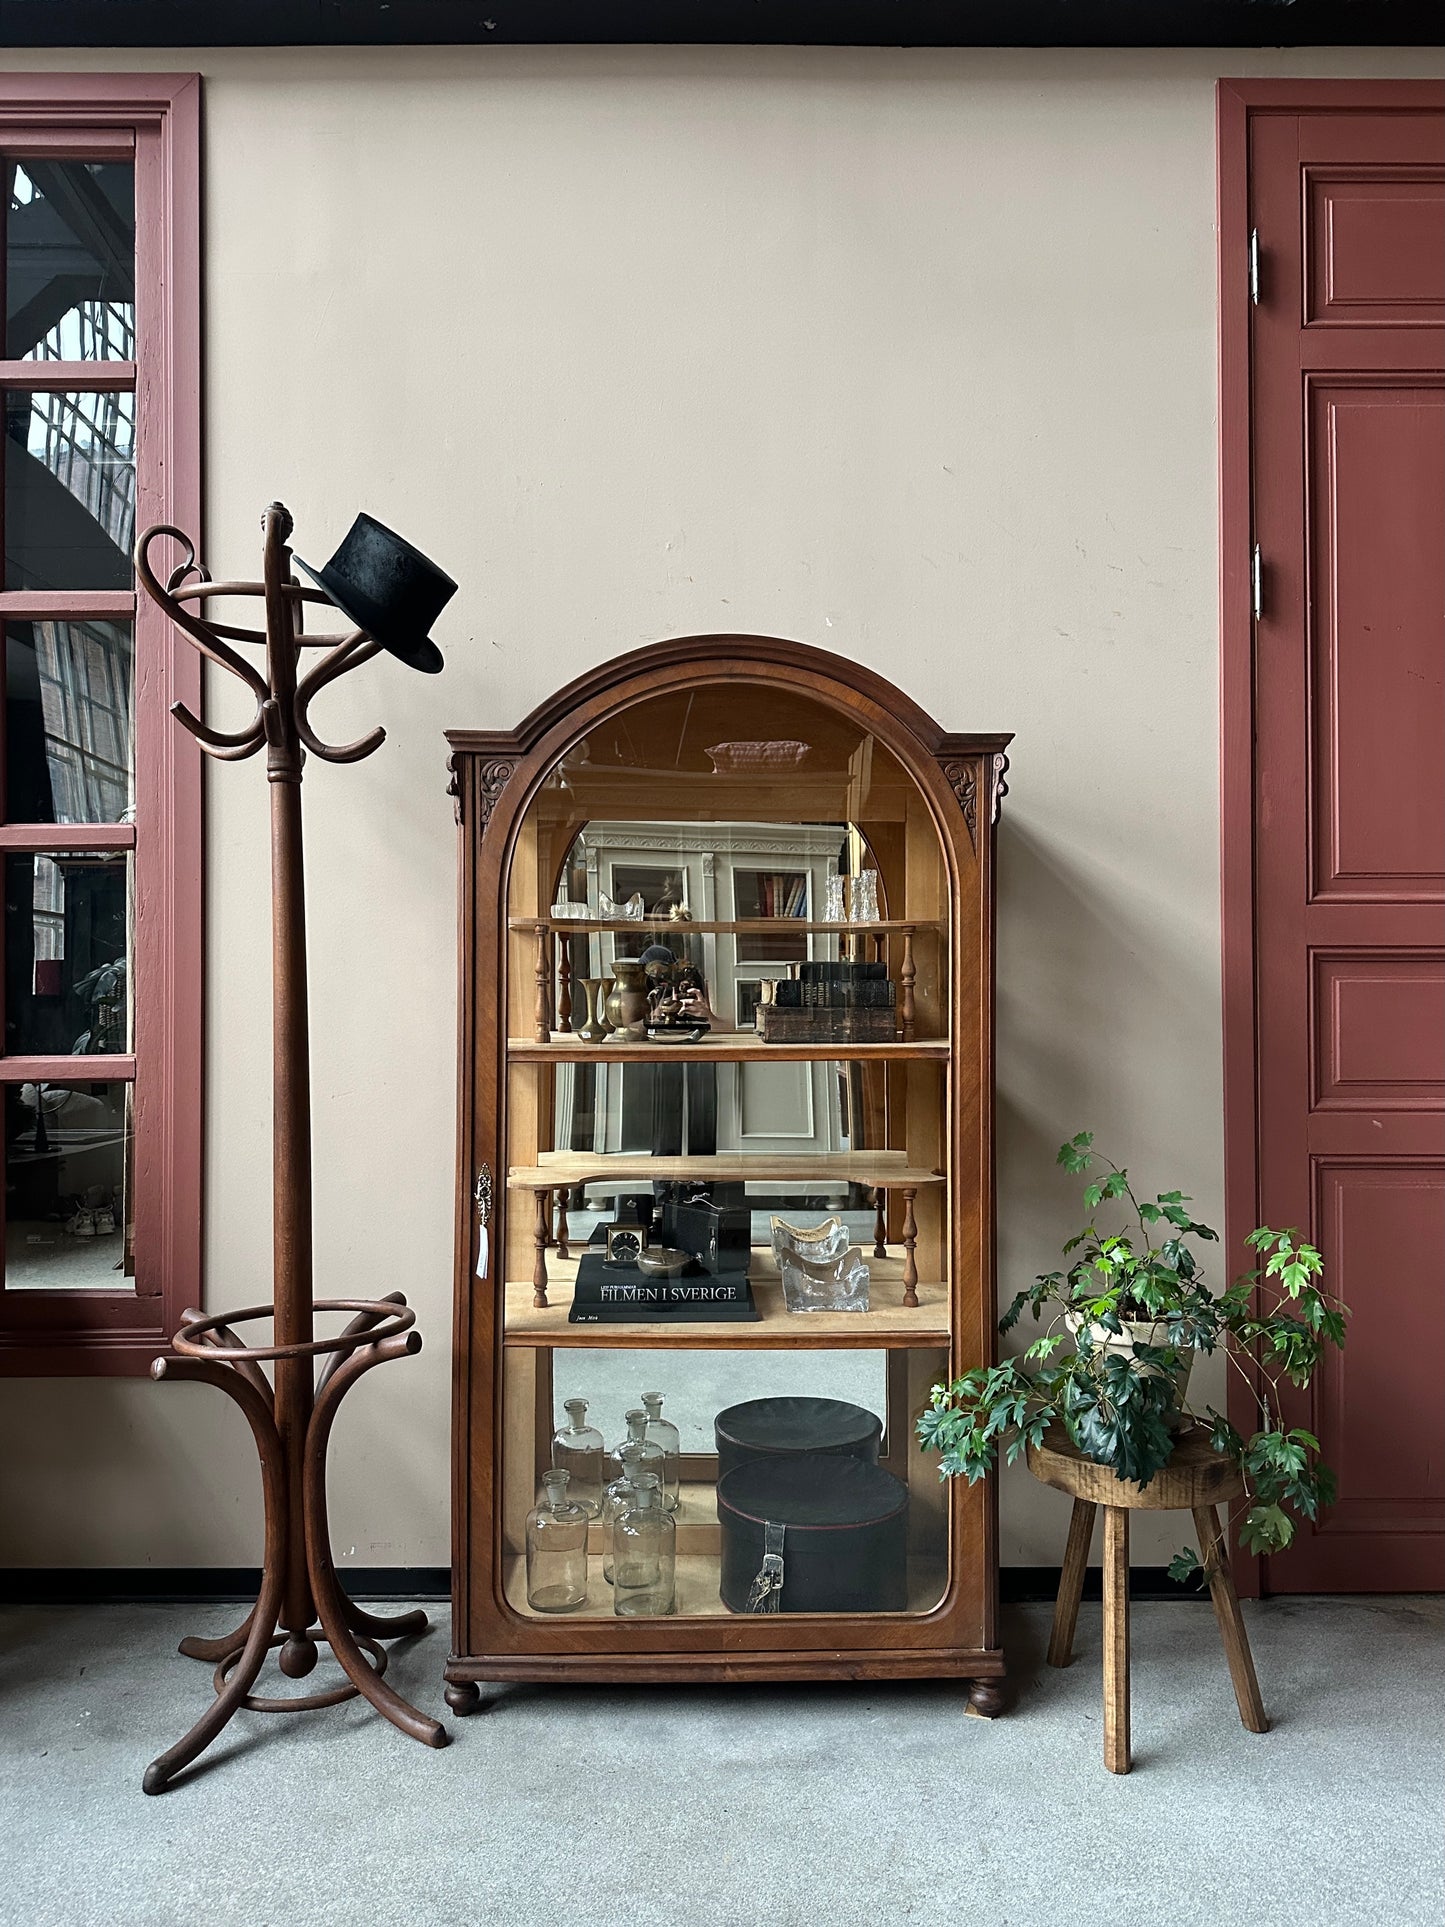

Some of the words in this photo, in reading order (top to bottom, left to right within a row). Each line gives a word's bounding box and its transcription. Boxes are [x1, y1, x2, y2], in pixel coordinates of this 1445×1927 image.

[600, 1288, 658, 1301] FILMEN
[662, 1287, 667, 1301] I
[671, 1287, 737, 1301] SVERIGE
